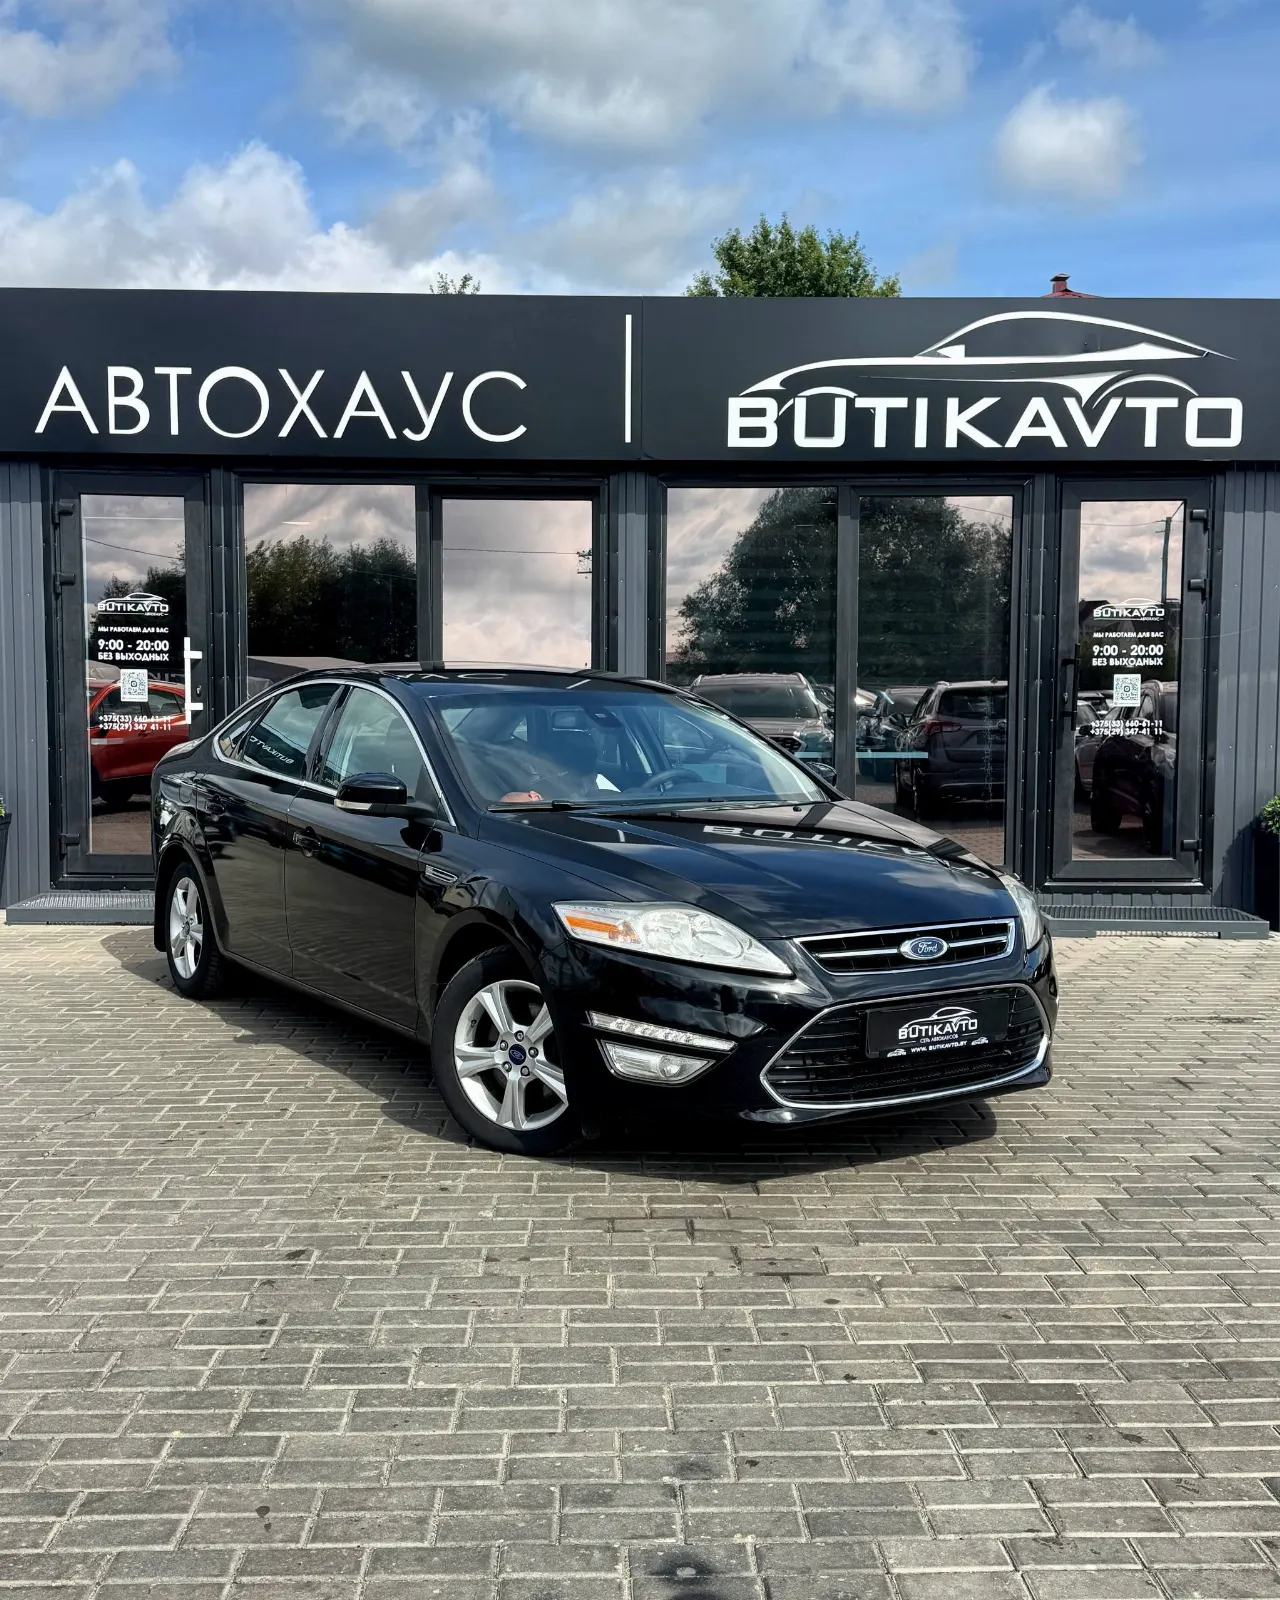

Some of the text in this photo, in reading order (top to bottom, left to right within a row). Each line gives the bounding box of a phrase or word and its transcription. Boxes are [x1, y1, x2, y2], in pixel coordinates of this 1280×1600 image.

[34, 365, 528, 443] АВТОХАУС
[727, 396, 1244, 449] BUTIKAVTO
[97, 602, 169, 612] BUTIKAVTO
[1093, 608, 1165, 617] BUTIKAVTO
[98, 639, 124, 650] 9:00
[136, 640, 169, 651] 20:00
[1092, 645, 1118, 656] 9:00
[1130, 645, 1164, 656] 20:00
[98, 652, 169, 661] БЕЗ ВЫХОДНЫХ
[1092, 658, 1163, 666] БЕЗ ВЫХОДНЫХ
[1090, 720, 1124, 728] +375(33)
[1090, 727, 1124, 736] +375(29)
[917, 941, 939, 954] Ford
[898, 1019, 978, 1040] BUTIKAVTO
